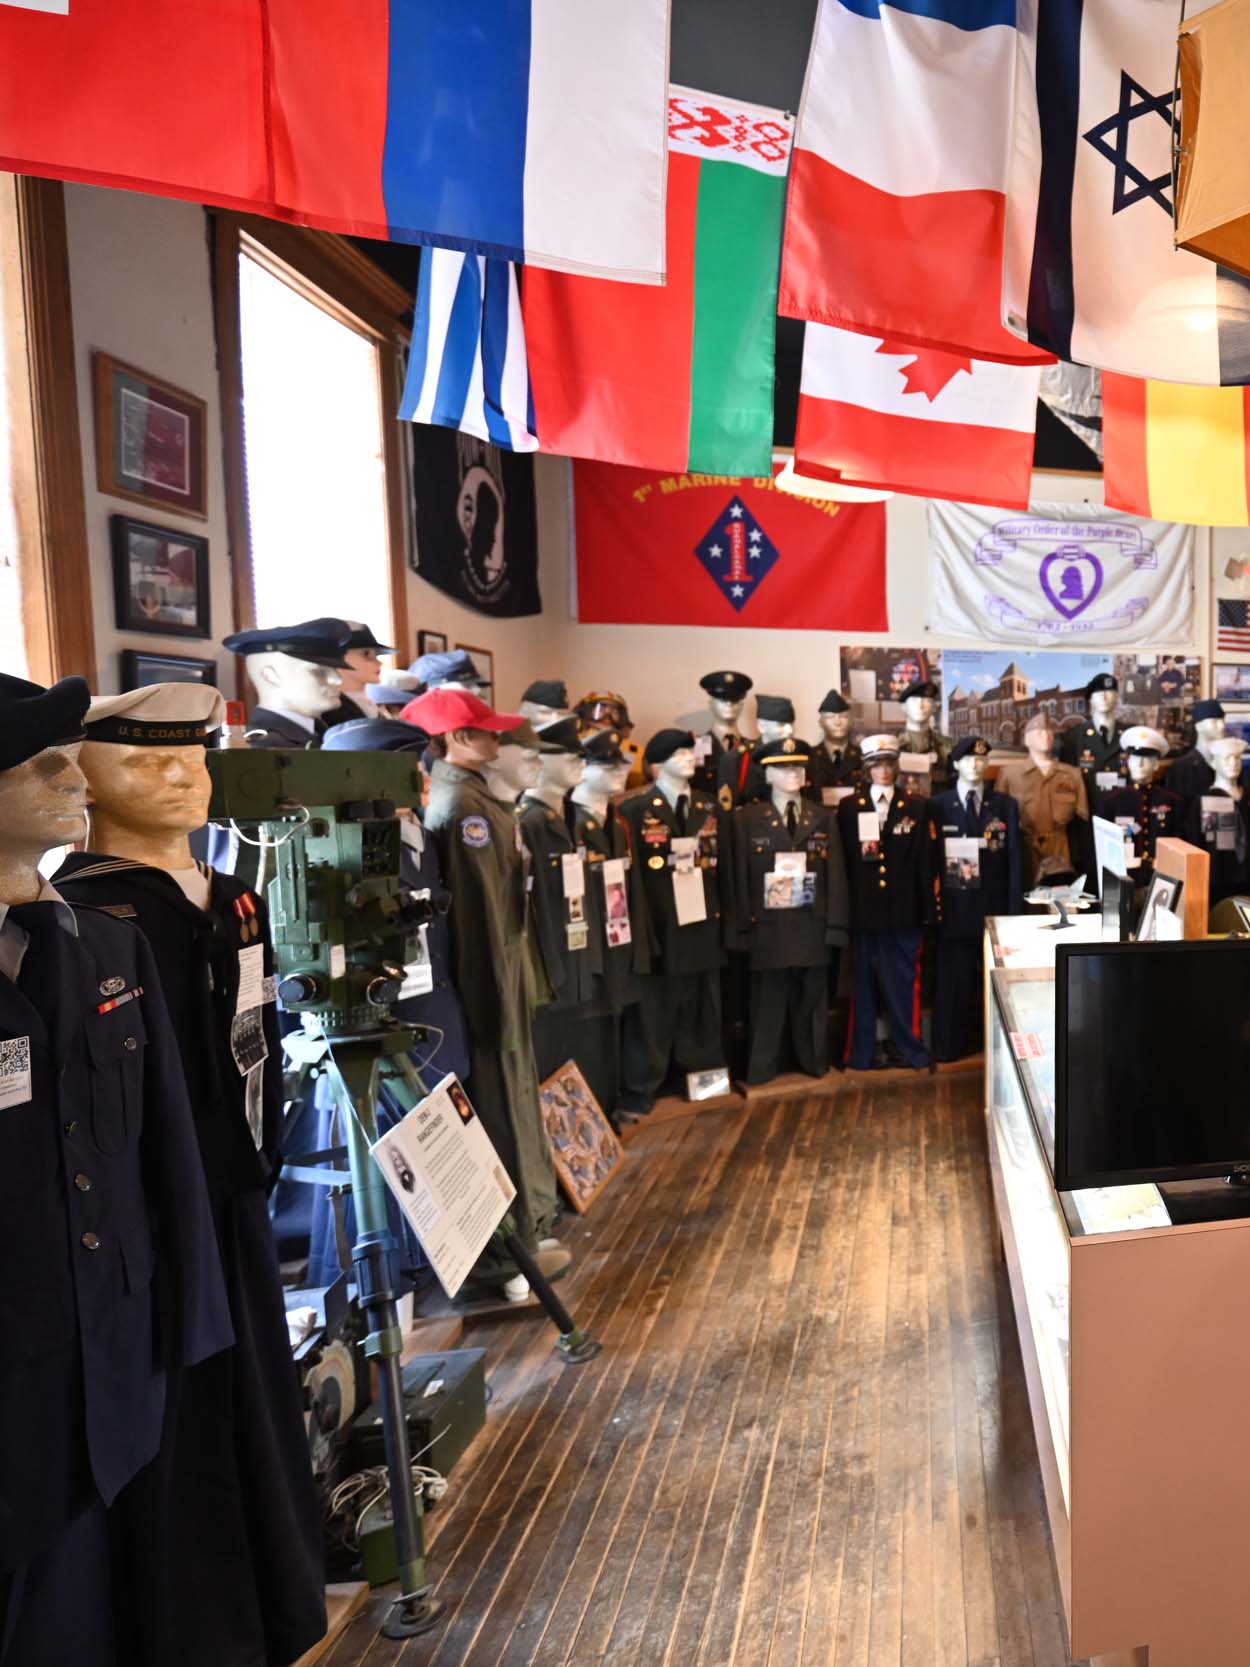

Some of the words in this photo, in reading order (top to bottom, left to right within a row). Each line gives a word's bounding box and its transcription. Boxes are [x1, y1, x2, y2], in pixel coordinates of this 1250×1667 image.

[658, 472, 741, 494] MARINE
[752, 476, 841, 518] DISION
[998, 524, 1032, 538] Military
[1034, 524, 1058, 536] Order
[1060, 524, 1070, 536] of
[1072, 525, 1084, 536] the
[1087, 526, 1113, 539] Purple
[148, 728, 190, 738] COAST
